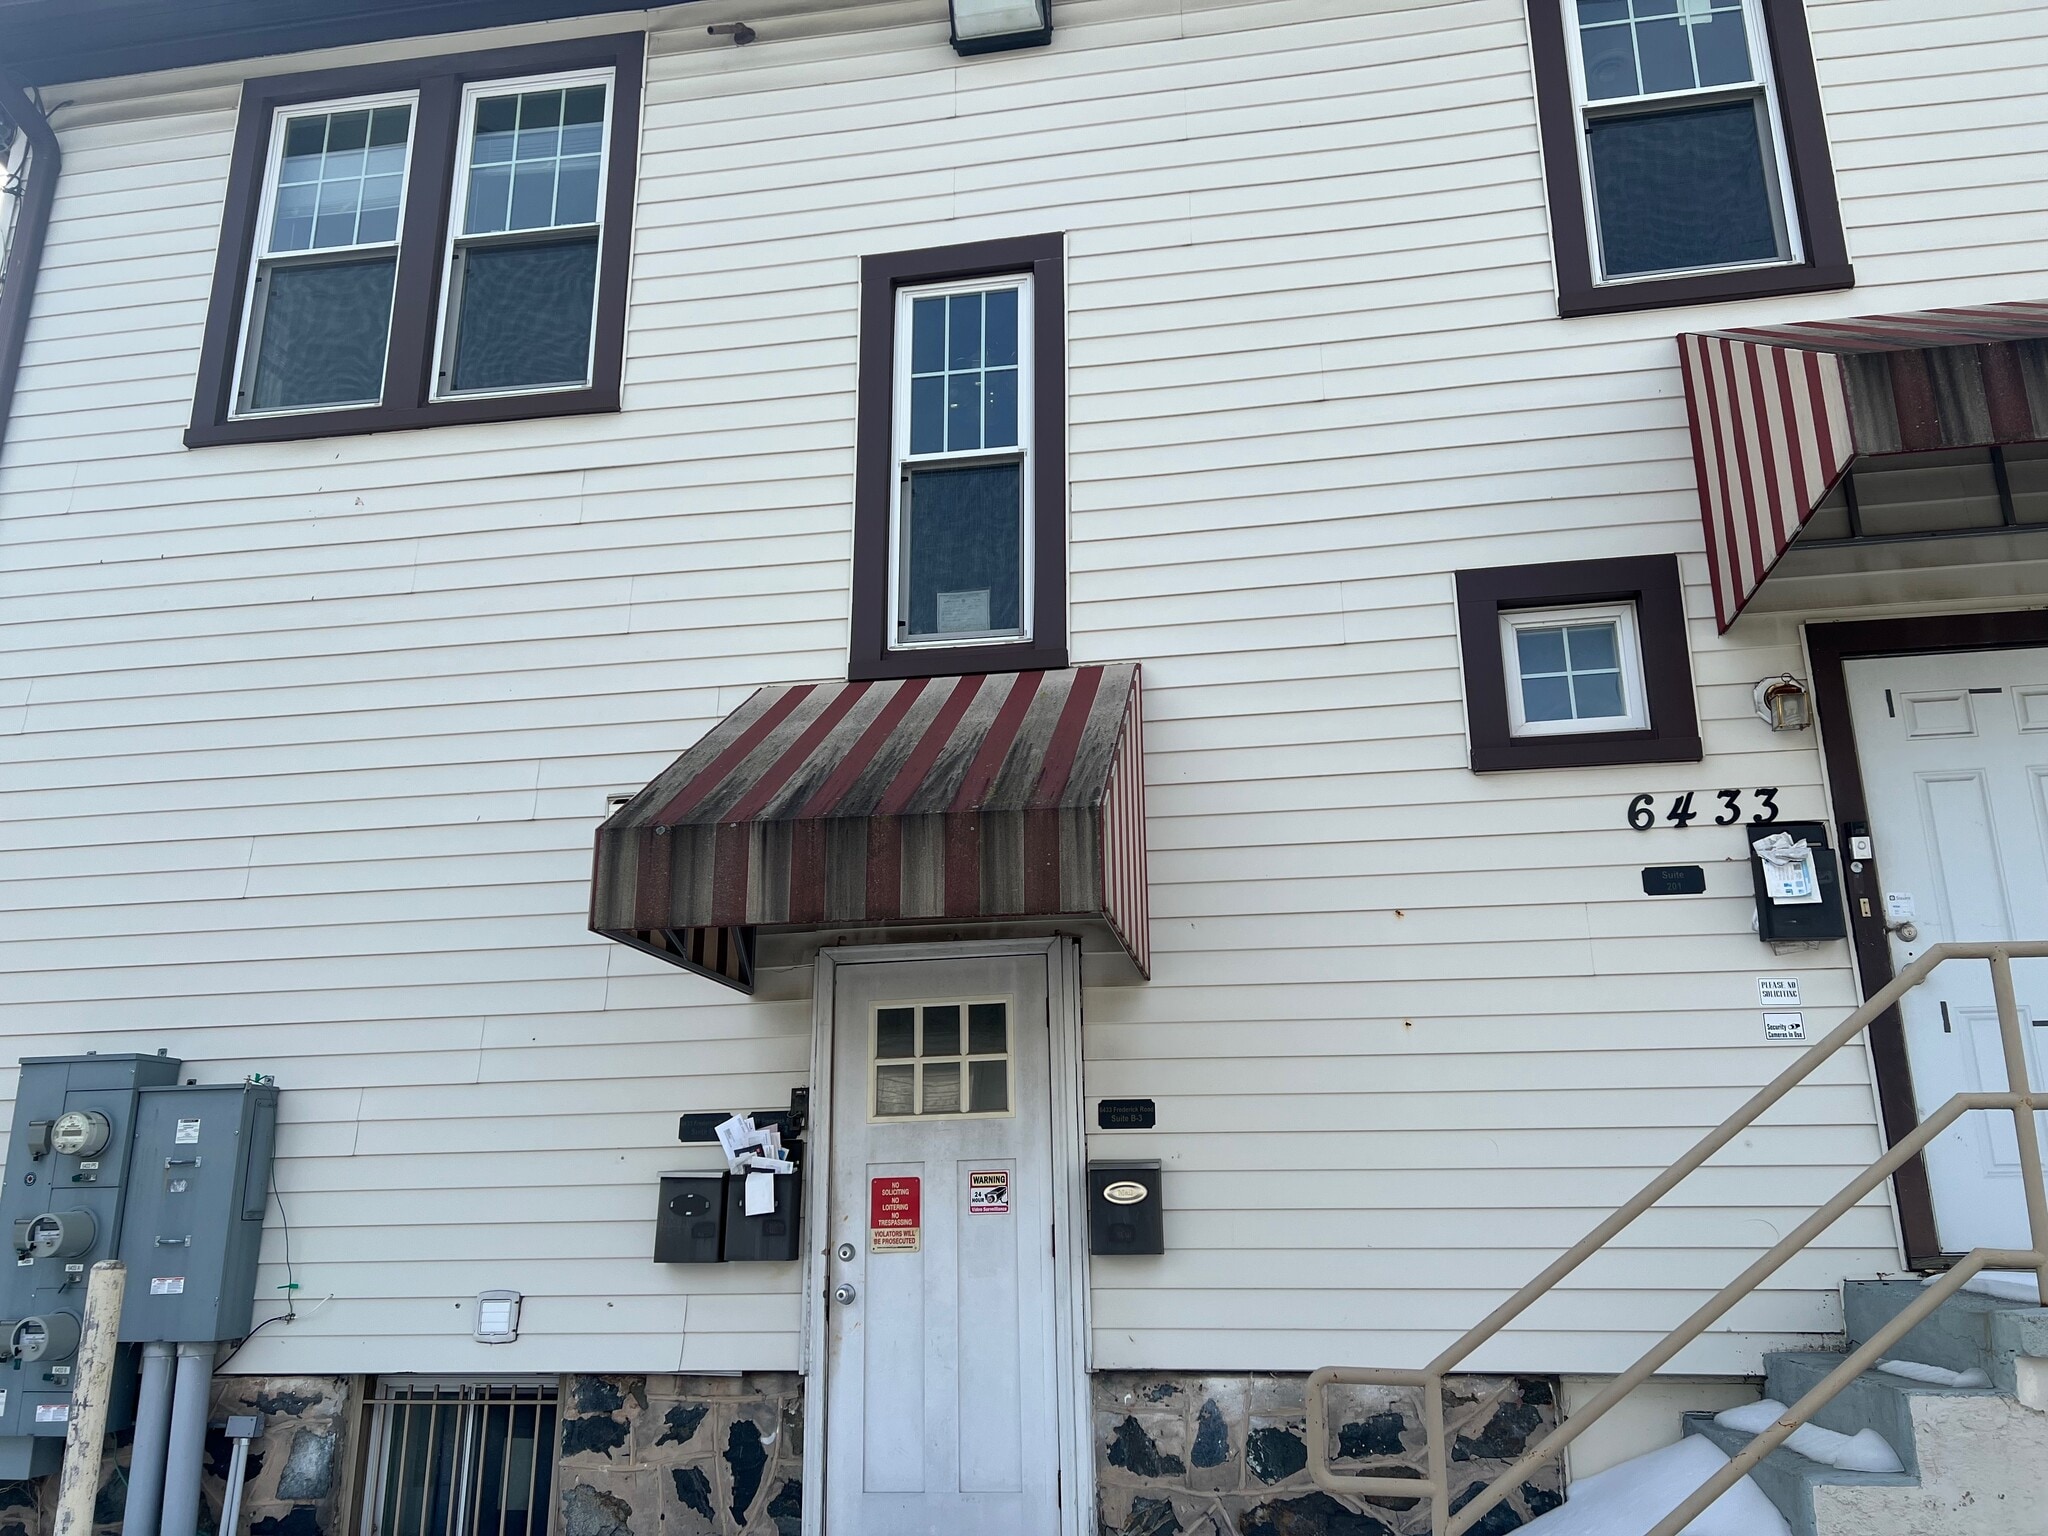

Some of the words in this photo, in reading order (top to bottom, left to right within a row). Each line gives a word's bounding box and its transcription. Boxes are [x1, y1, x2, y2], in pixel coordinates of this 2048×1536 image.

[1628, 788, 1779, 831] 6433
[1662, 871, 1685, 879] Suite
[1761, 981, 1785, 989] PLEASE
[1787, 981, 1796, 989] NO
[1767, 1023, 1787, 1031] Security
[1111, 1114, 1129, 1122] Suite
[973, 1175, 1006, 1184] WARNING
[881, 1188, 910, 1196] SOLICITING
[882, 1237, 916, 1245] PROSECUTED
